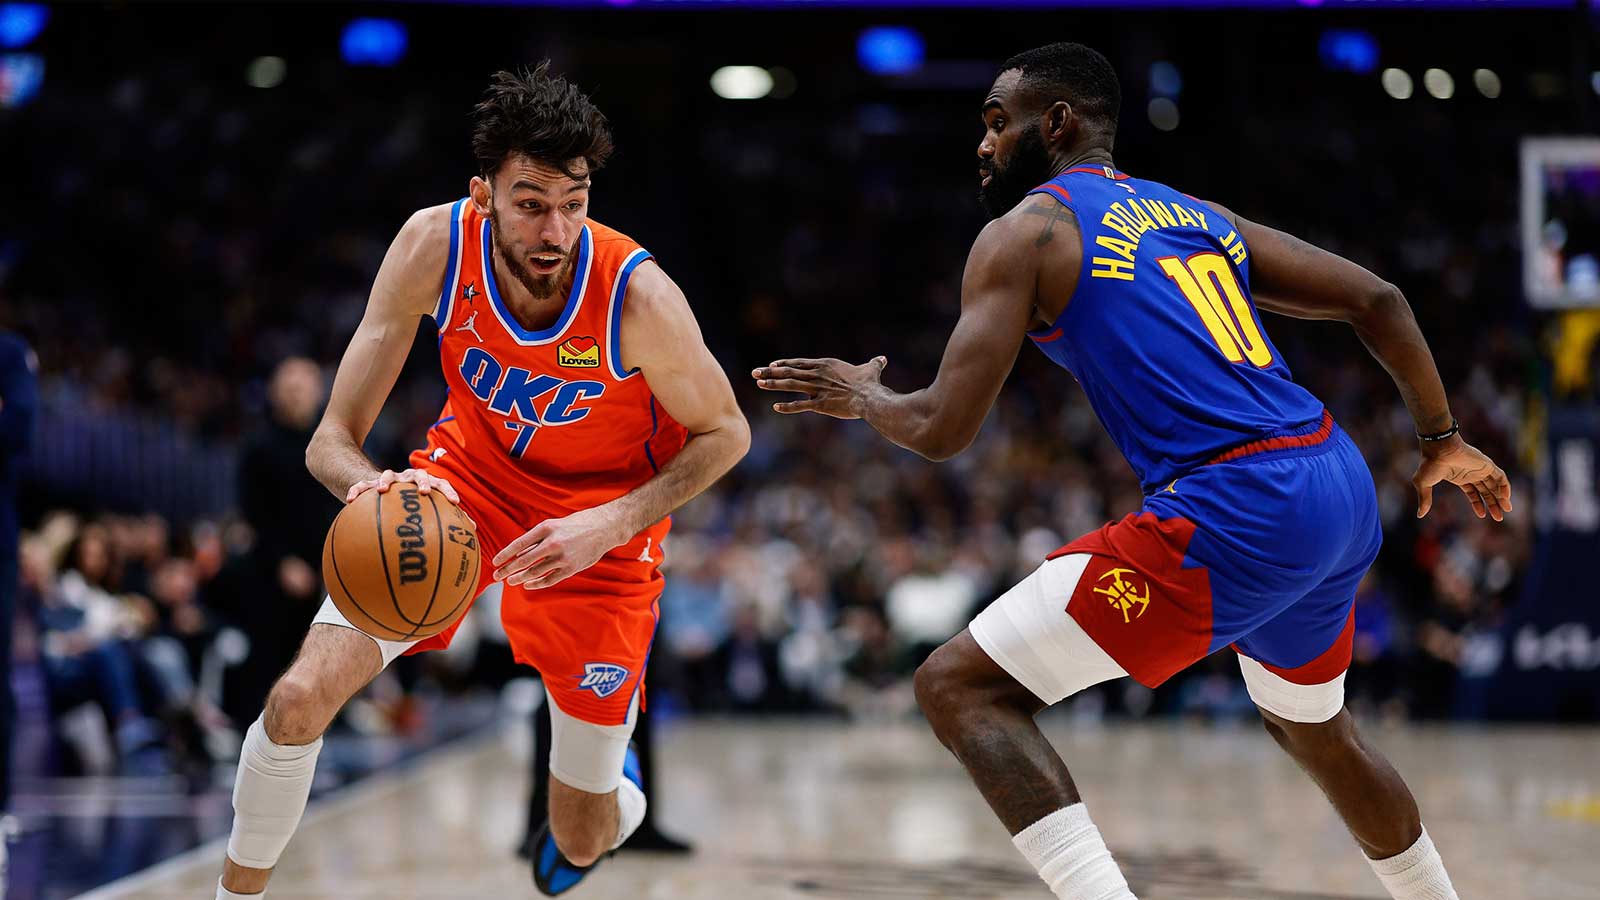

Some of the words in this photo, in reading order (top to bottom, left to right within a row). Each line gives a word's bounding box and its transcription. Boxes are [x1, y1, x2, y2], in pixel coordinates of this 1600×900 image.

[1091, 198, 1210, 281] HARDAWAY
[1219, 230, 1247, 266] JR
[1154, 252, 1274, 369] 10
[459, 347, 606, 427] OKC
[503, 420, 538, 460] 7
[396, 488, 428, 586] Wilson
[579, 671, 619, 687] OKC
